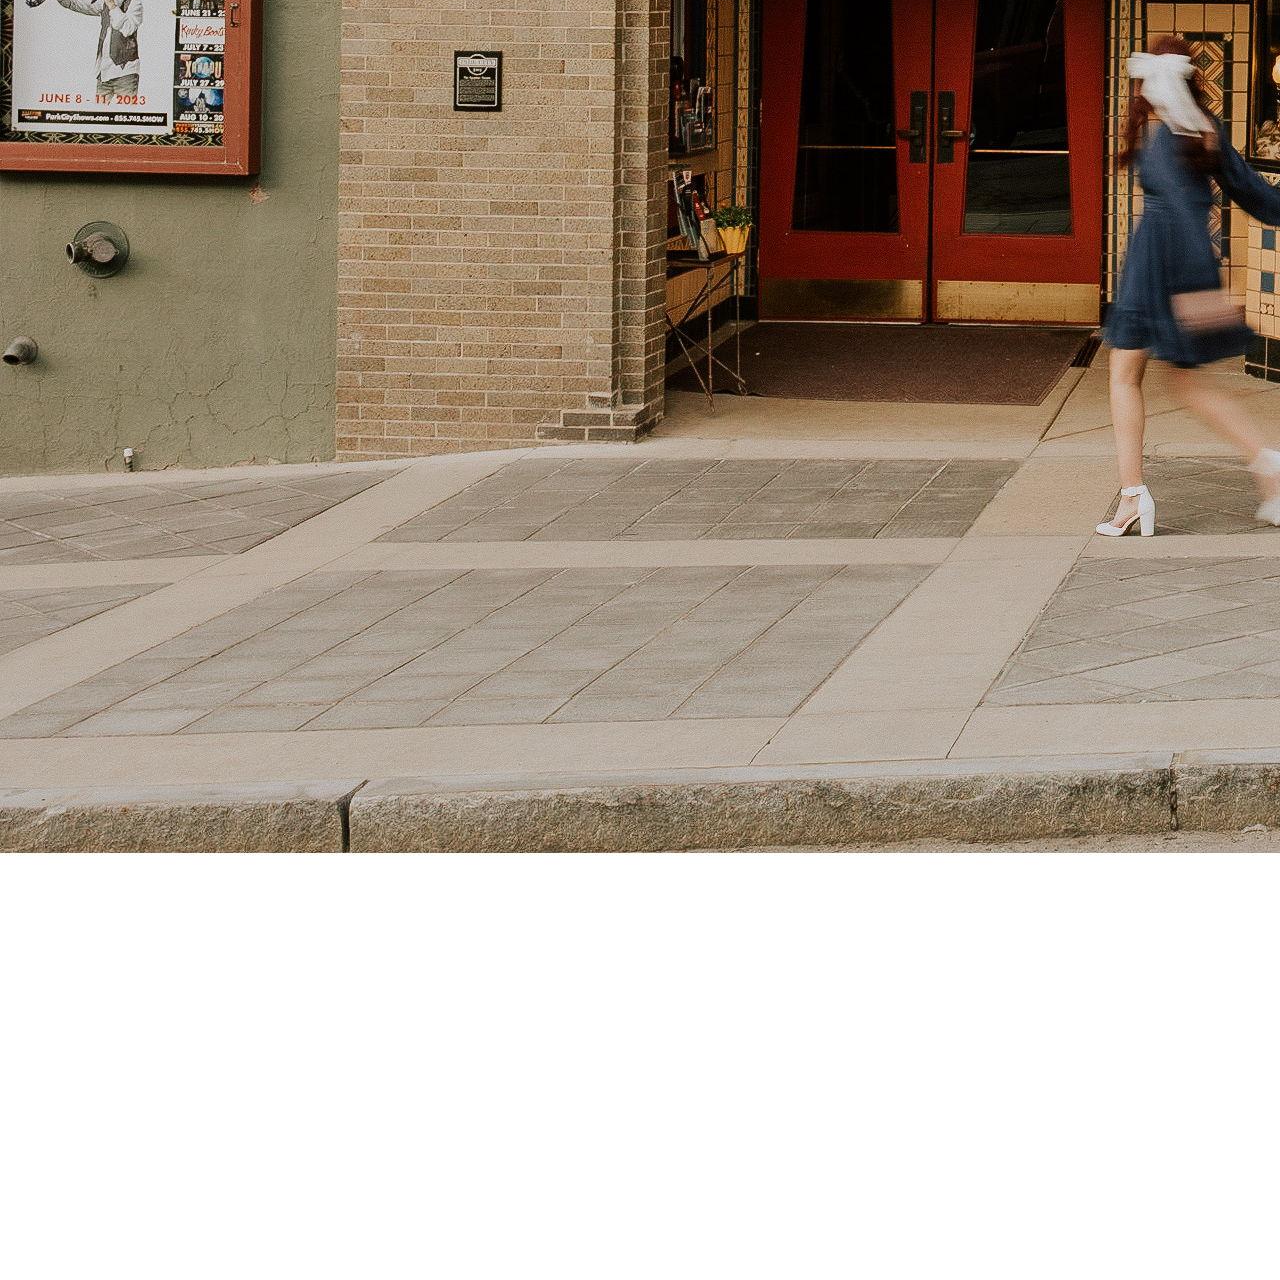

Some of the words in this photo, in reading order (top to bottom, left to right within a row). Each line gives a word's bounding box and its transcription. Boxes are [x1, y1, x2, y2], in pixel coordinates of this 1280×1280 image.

[181, 9, 201, 17] JUNE
[180, 79, 199, 87] JULY
[39, 93, 71, 103] JUNE
[75, 94, 82, 104] 8
[95, 94, 111, 106] 11,
[116, 94, 146, 106] 2023
[199, 113, 209, 121] 10
